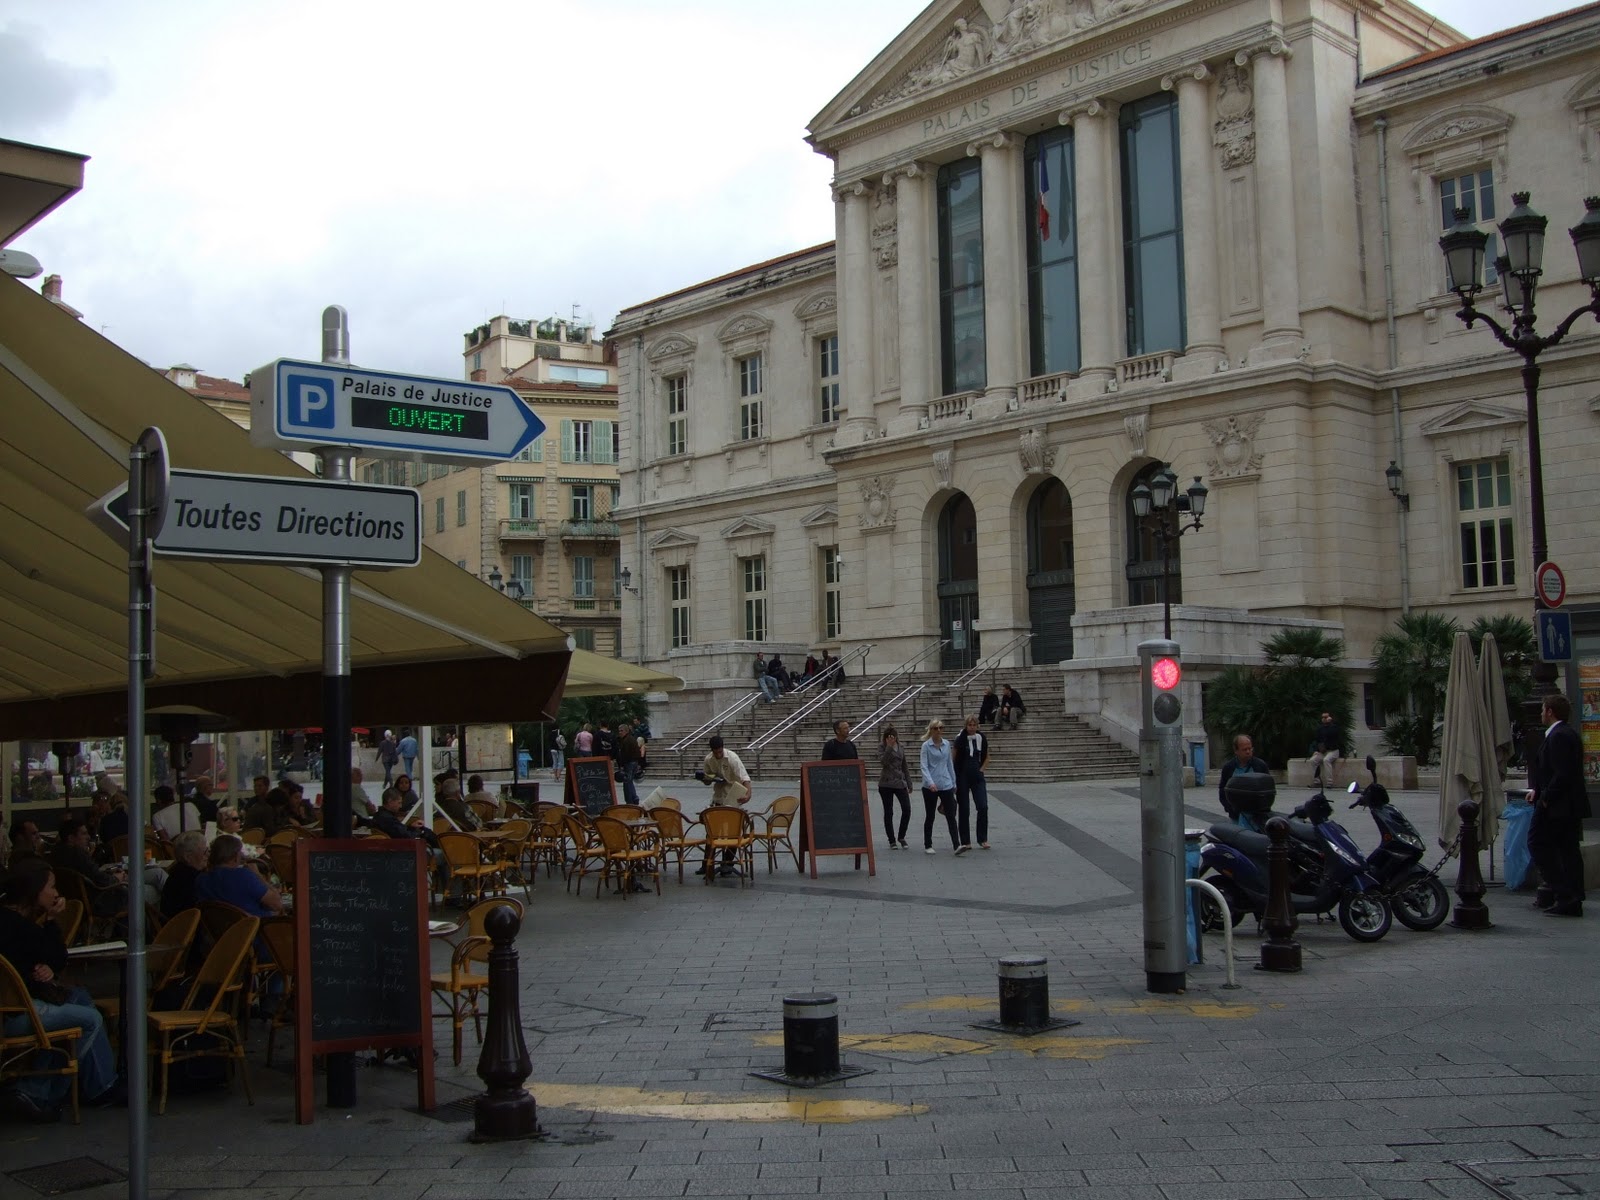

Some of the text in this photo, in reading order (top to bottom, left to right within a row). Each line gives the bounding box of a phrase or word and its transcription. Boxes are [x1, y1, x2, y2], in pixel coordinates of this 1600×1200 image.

[922, 39, 1152, 138] PALAIS DE JUSTICE
[300, 384, 328, 422] P
[342, 377, 493, 408] Palais de Justice
[388, 407, 465, 432] OUVERT
[174, 498, 405, 541] Toutes Directions
